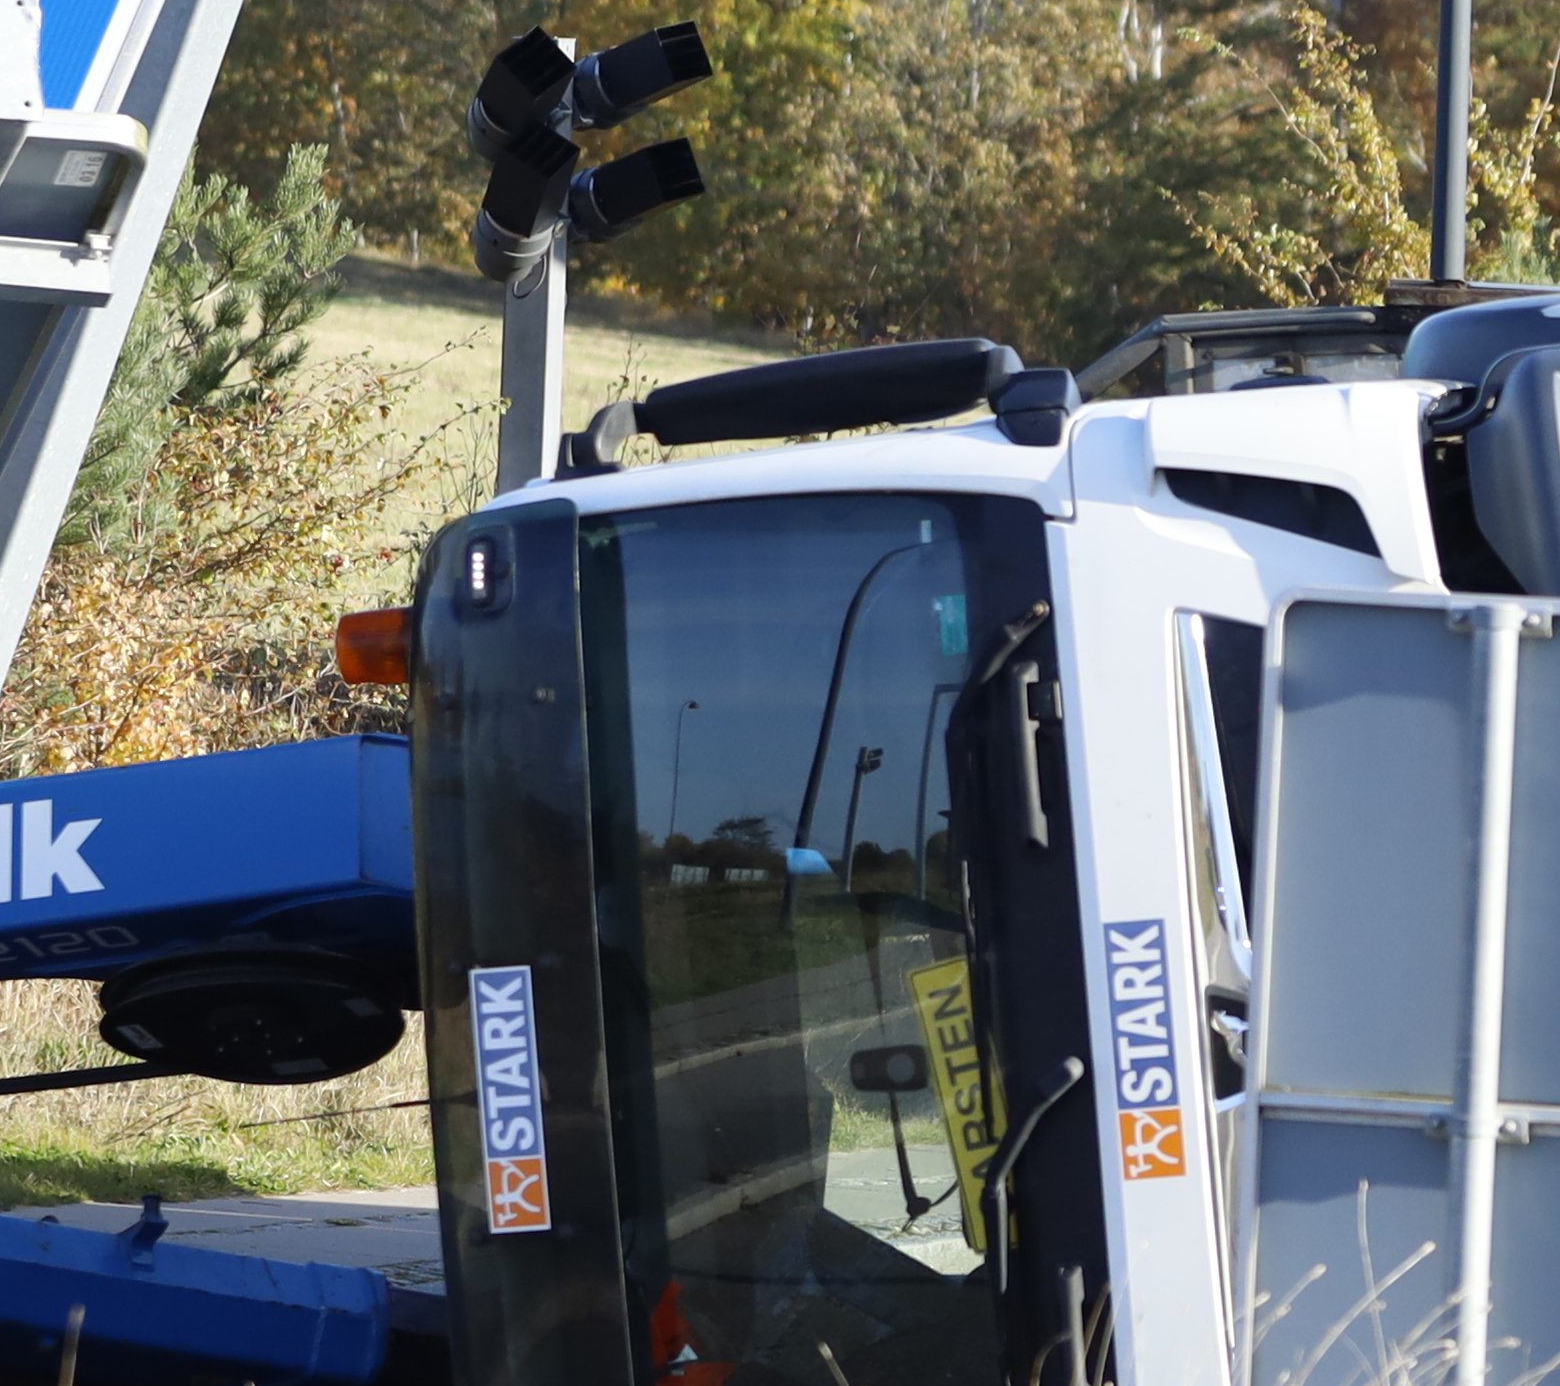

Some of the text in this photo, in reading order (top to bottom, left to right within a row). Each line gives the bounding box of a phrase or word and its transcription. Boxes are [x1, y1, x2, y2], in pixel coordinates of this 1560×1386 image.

[478, 975, 536, 1152] STARK
[927, 981, 1000, 1187] ARSTEN
[1108, 923, 1174, 1105] STARK
